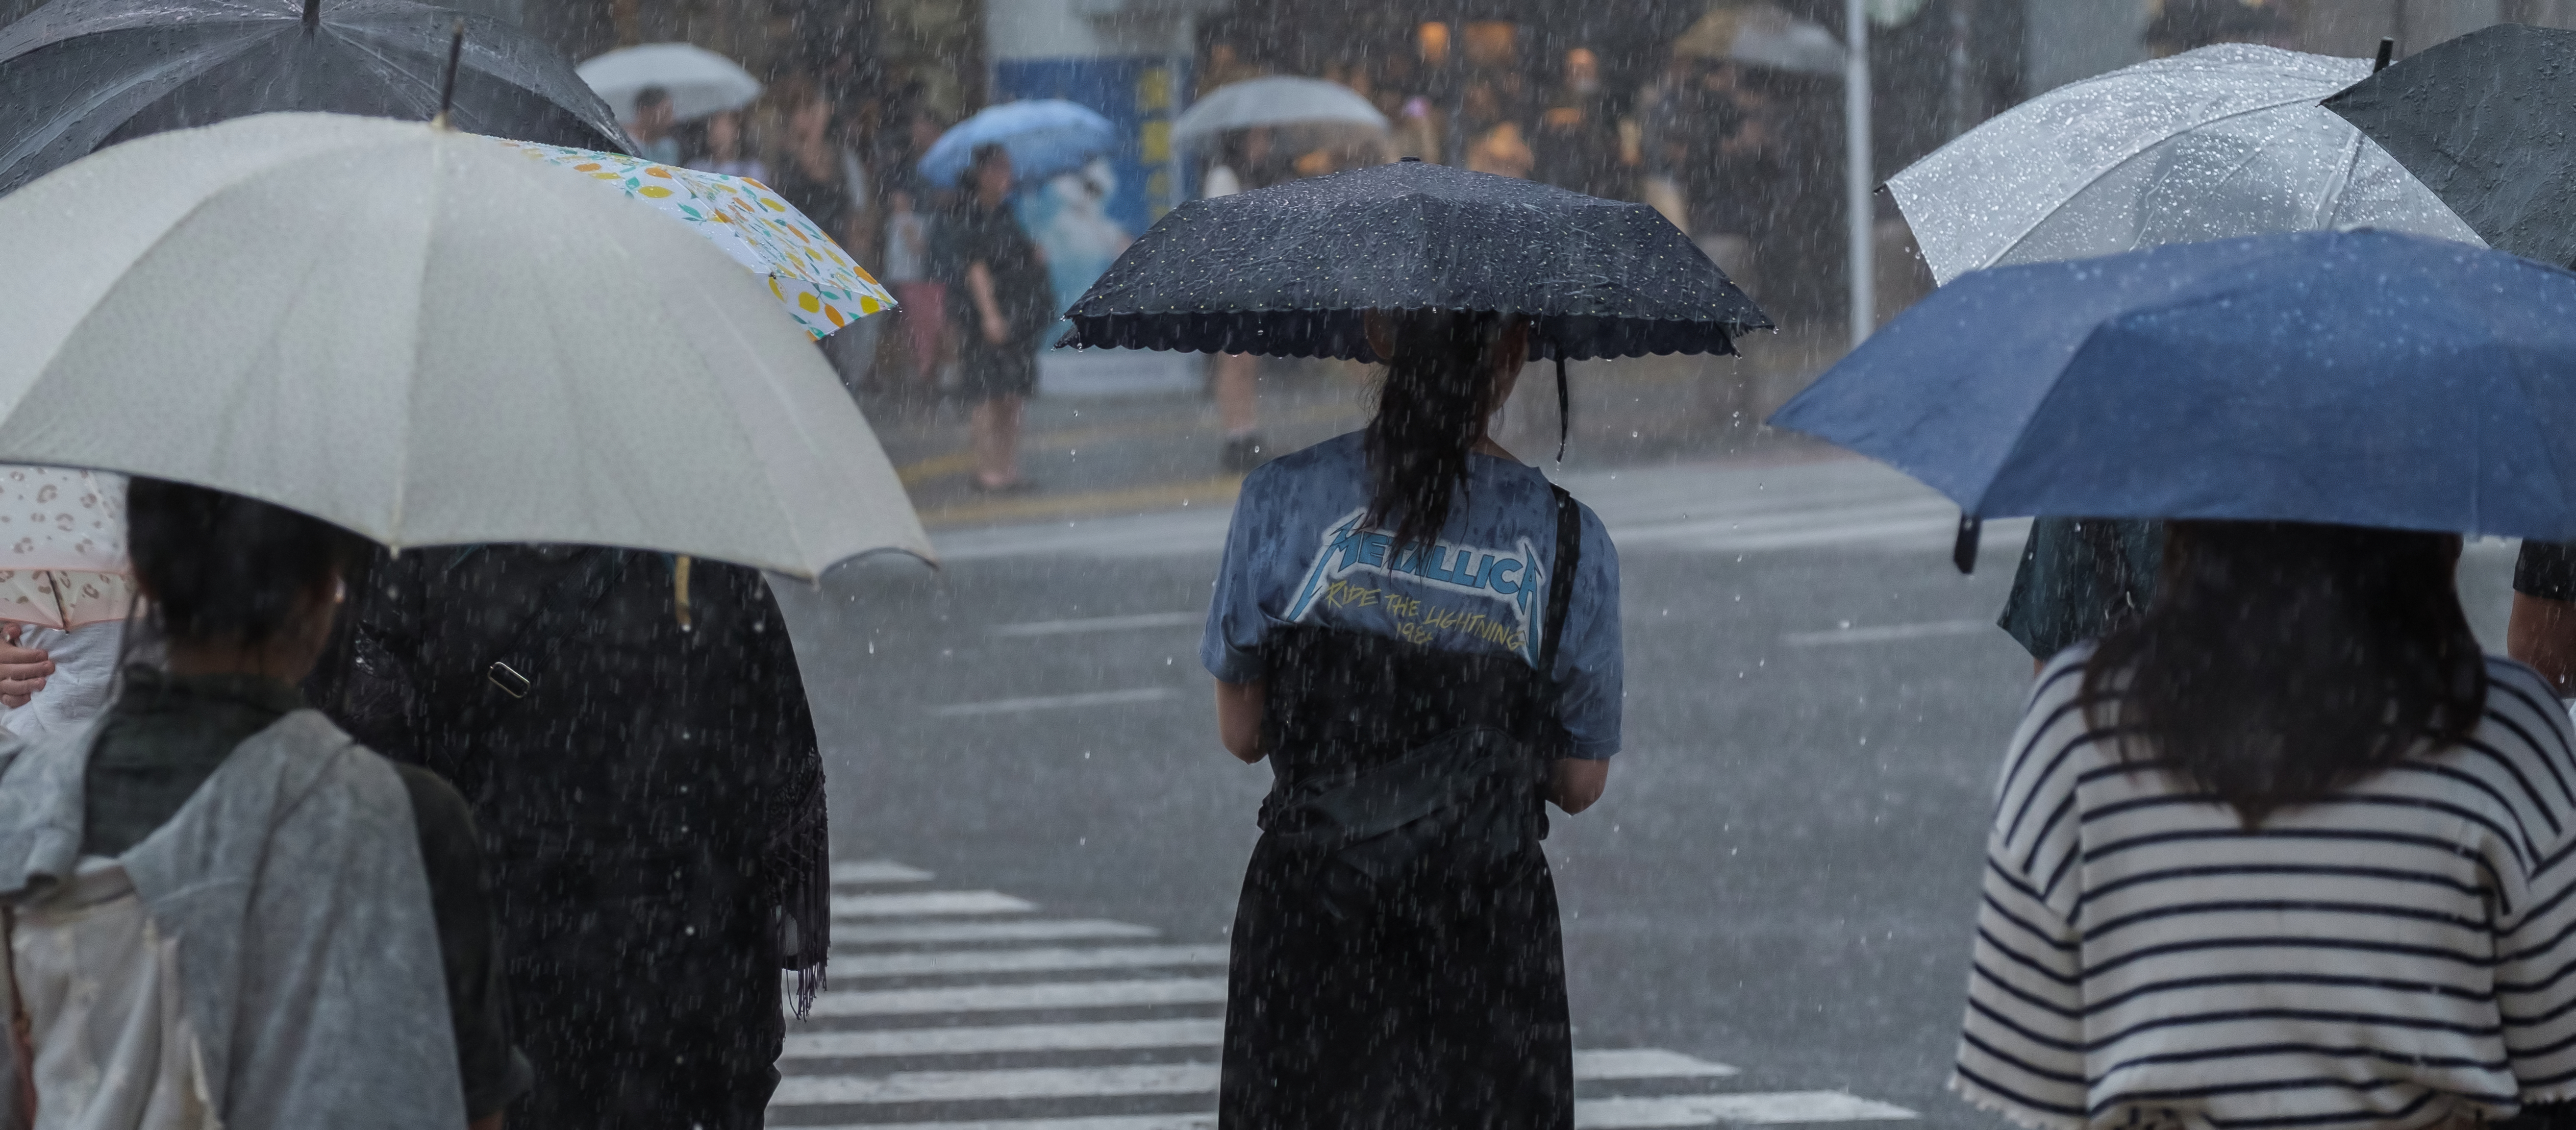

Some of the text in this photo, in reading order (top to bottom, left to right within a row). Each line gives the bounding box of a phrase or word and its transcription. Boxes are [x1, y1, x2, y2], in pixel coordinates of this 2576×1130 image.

[1287, 512, 1543, 670] METALLICA
[1326, 580, 1526, 652] RIDE THE LIGHTNING
